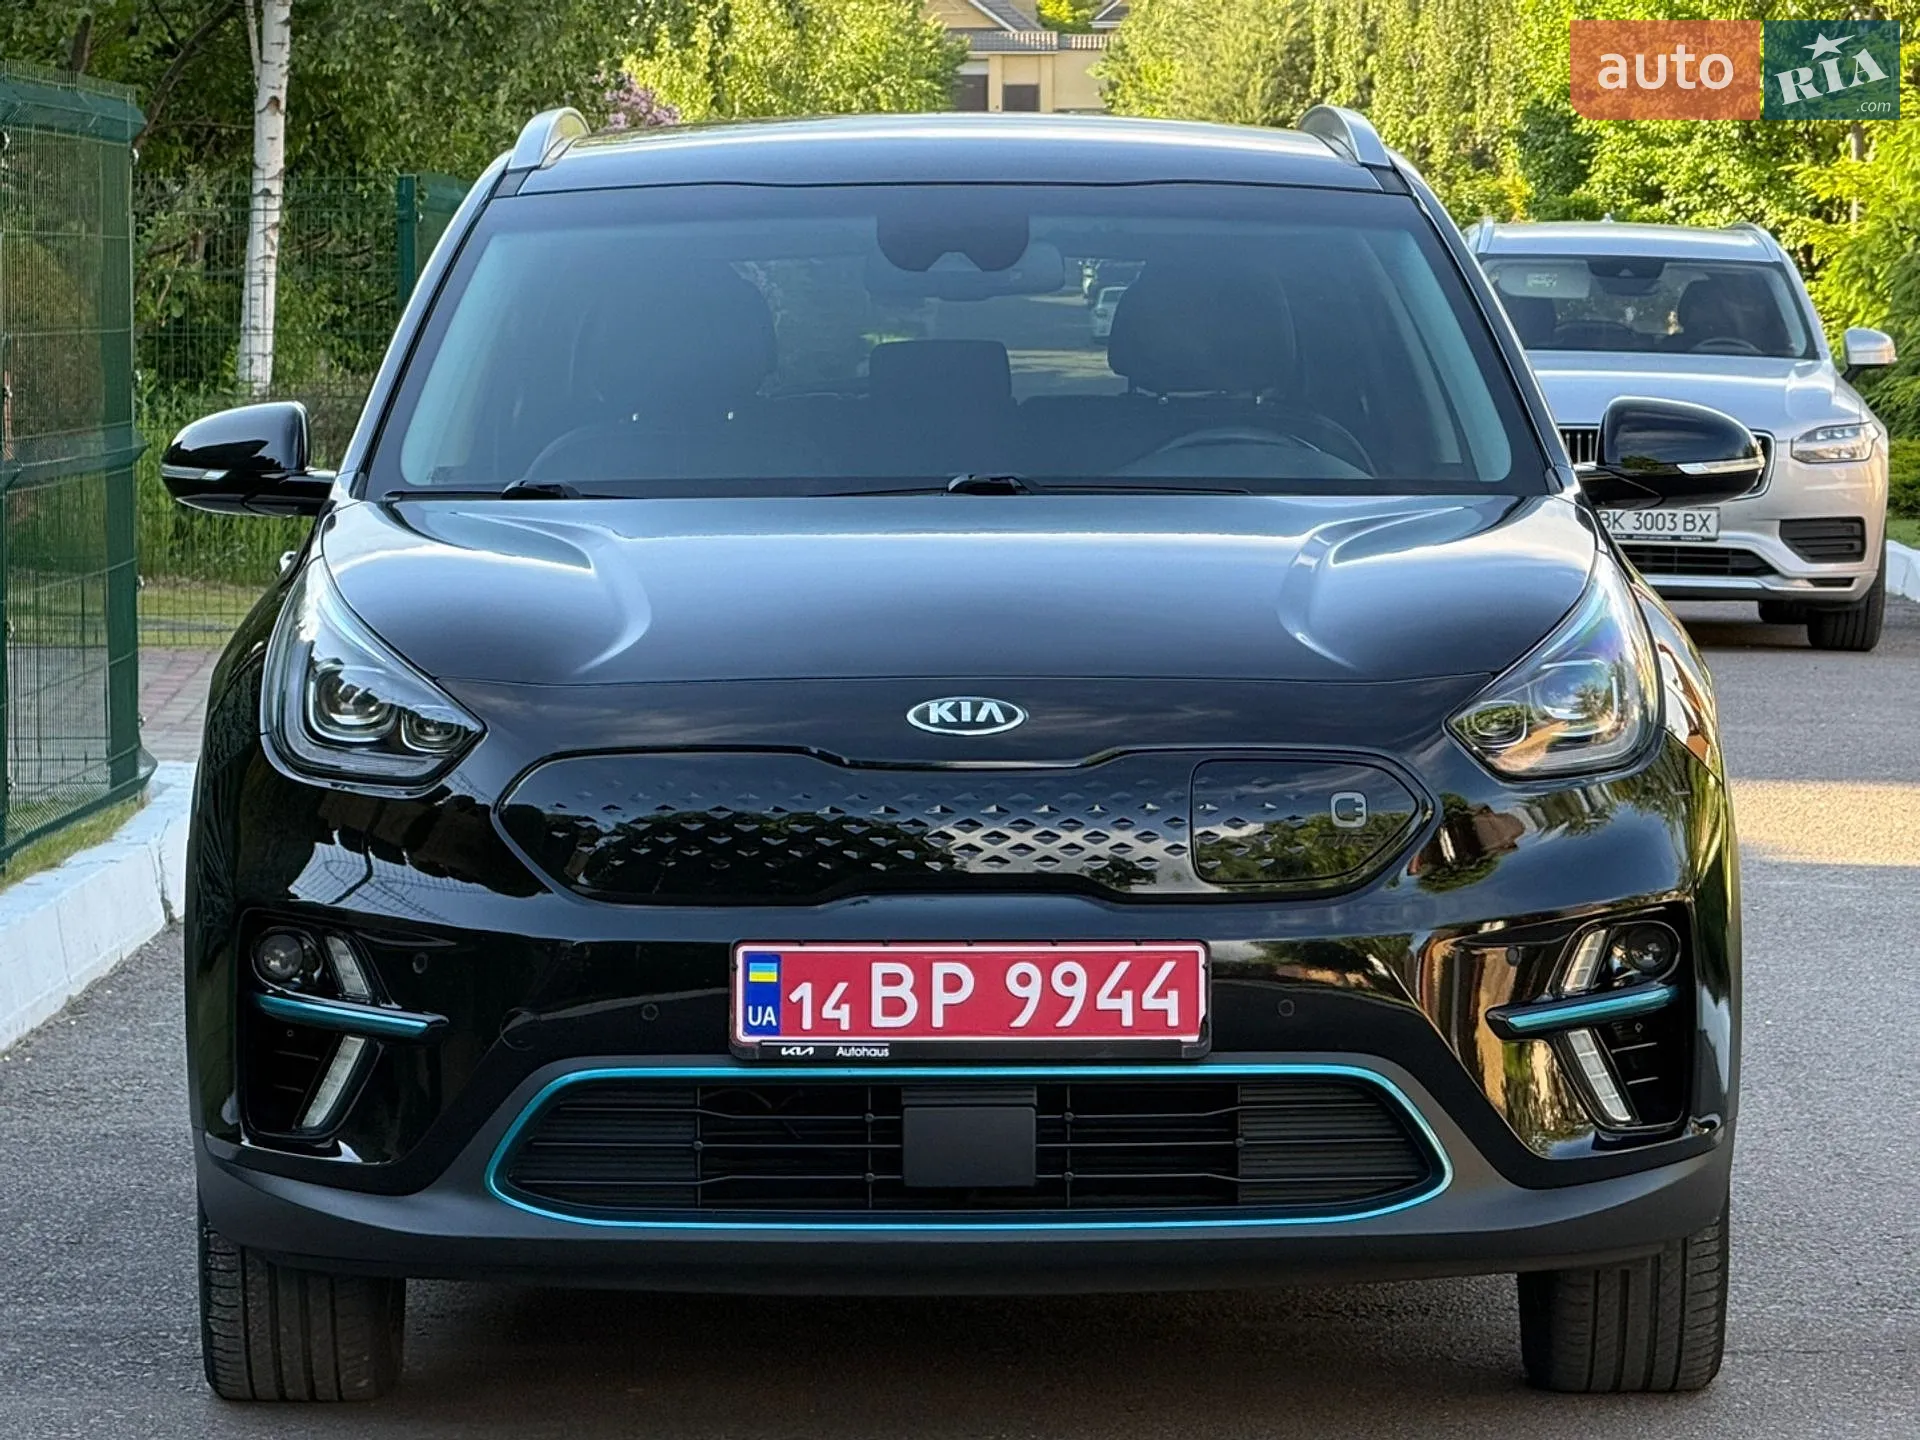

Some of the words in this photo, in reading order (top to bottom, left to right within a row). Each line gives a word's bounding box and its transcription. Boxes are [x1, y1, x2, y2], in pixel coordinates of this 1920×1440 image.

[1633, 512, 1677, 532] 3003
[1683, 513, 1711, 533] BX
[929, 701, 1005, 724] KIA
[788, 981, 850, 1030] 14
[871, 962, 975, 1028] BP
[1005, 961, 1179, 1027] 9944
[748, 1005, 777, 1026] UA
[836, 1046, 889, 1057] Autohaus
